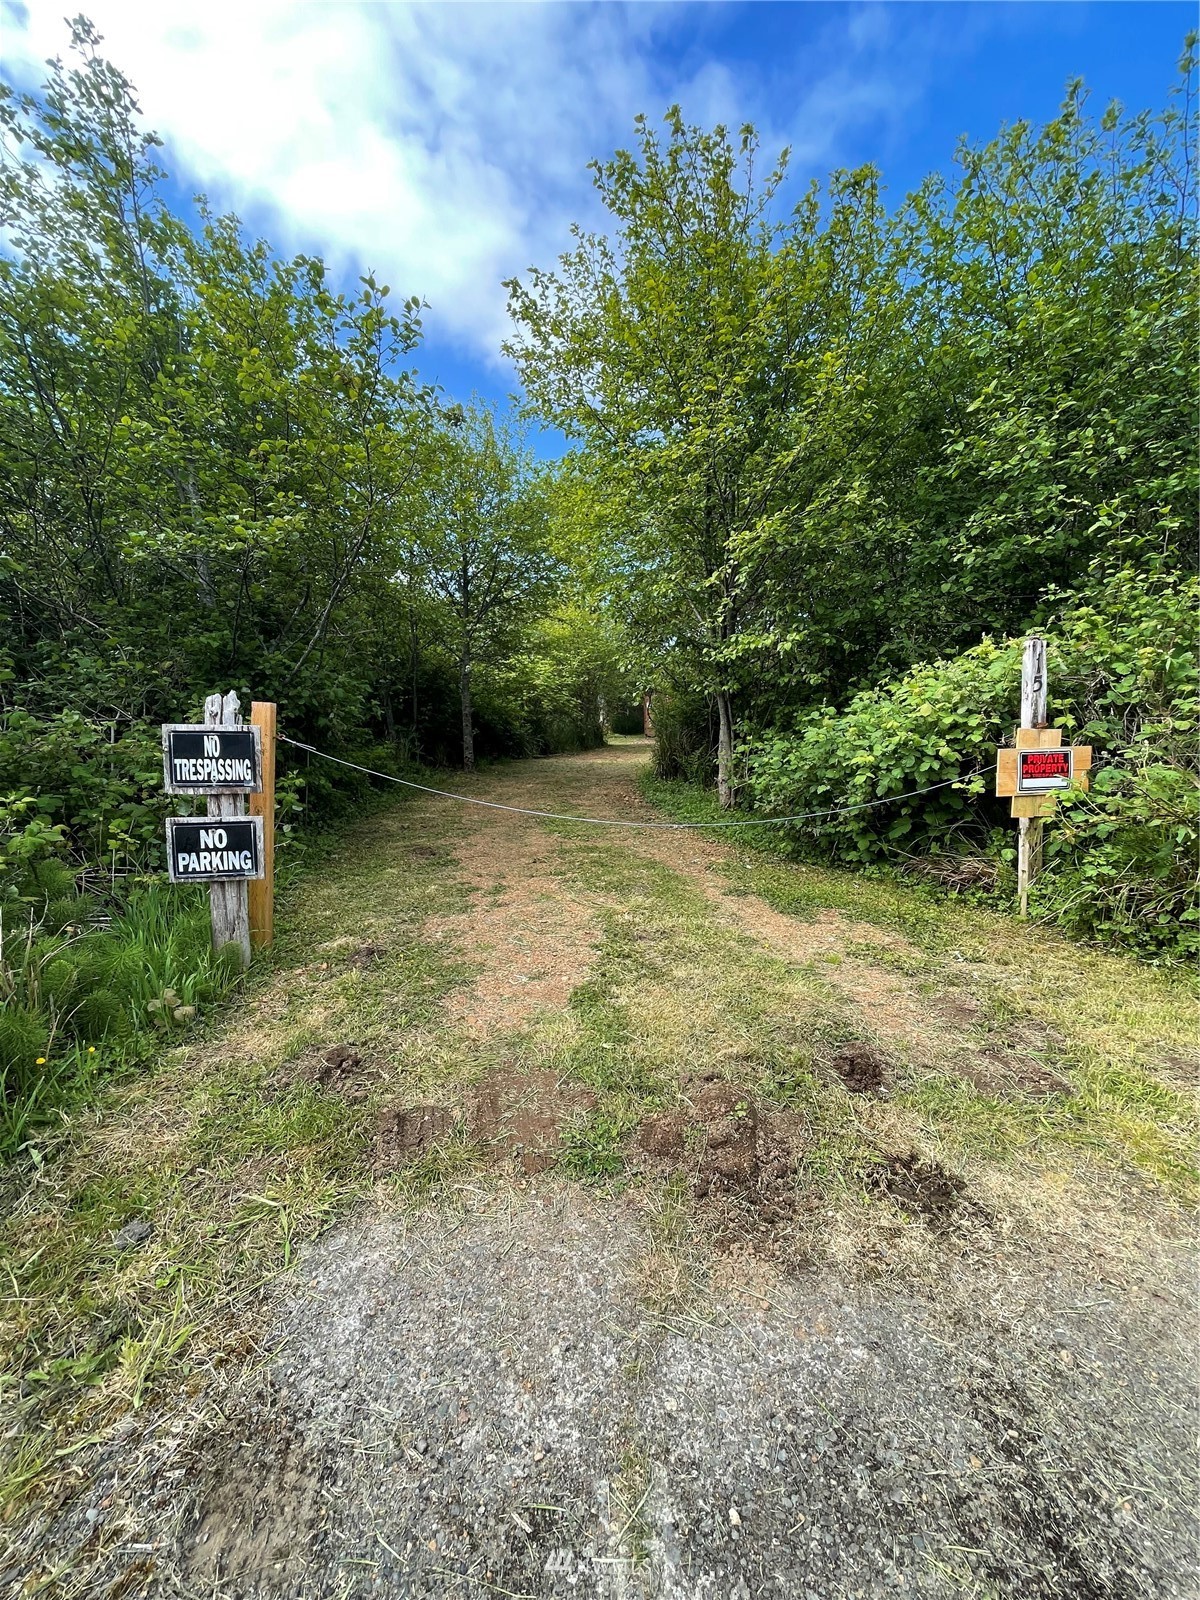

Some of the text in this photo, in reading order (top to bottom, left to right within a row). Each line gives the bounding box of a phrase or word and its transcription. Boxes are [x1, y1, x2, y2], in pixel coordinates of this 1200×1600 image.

[203, 735, 220, 757] NO
[174, 758, 252, 781] TRESPASSING
[1023, 763, 1068, 774] PROPERTY
[1027, 754, 1064, 764] PRIVATE
[199, 829, 228, 849] NO
[177, 850, 252, 872] PARKING
